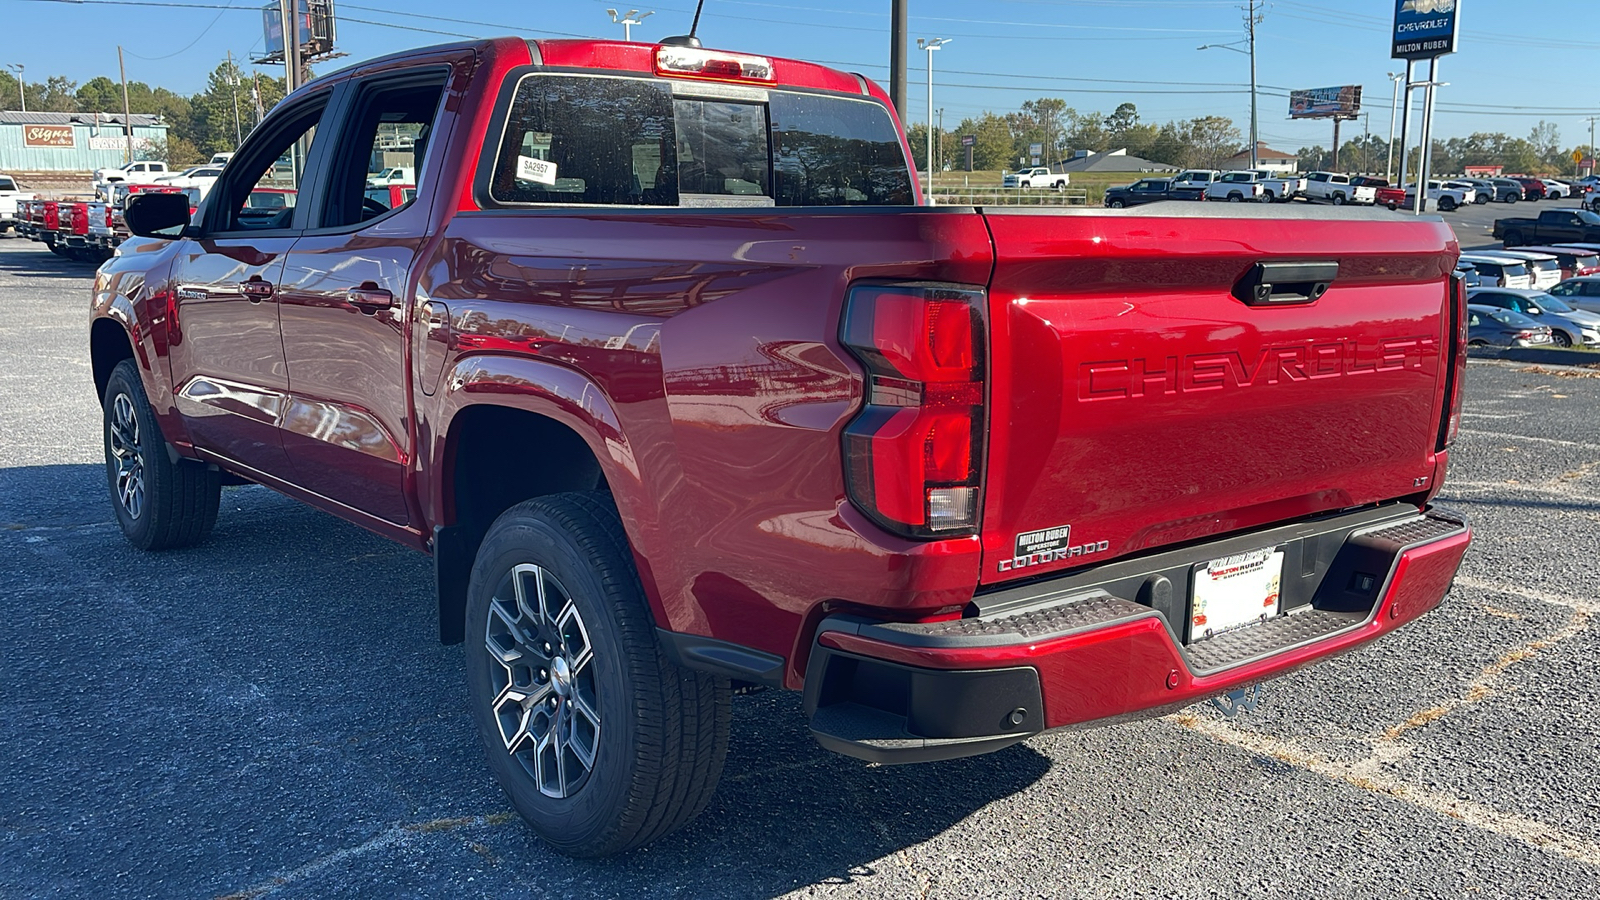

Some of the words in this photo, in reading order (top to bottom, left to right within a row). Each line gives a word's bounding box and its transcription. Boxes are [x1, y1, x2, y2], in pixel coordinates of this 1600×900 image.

[1398, 18, 1449, 33] CHEVROLET
[1396, 42, 1421, 53] MILTON
[1422, 40, 1448, 50] RUBEN
[28, 127, 69, 142] Signs
[93, 138, 148, 149] BANNRS
[524, 160, 549, 173] SA2957
[1078, 335, 1433, 401] CHEVROLET
[1412, 476, 1429, 487] LT
[1019, 532, 1045, 546] MILTON
[1045, 527, 1068, 541] RUBEN
[1027, 541, 1060, 551] SUPERSTORE
[998, 540, 1109, 571] COLORADO
[1212, 566, 1239, 577] MILTON
